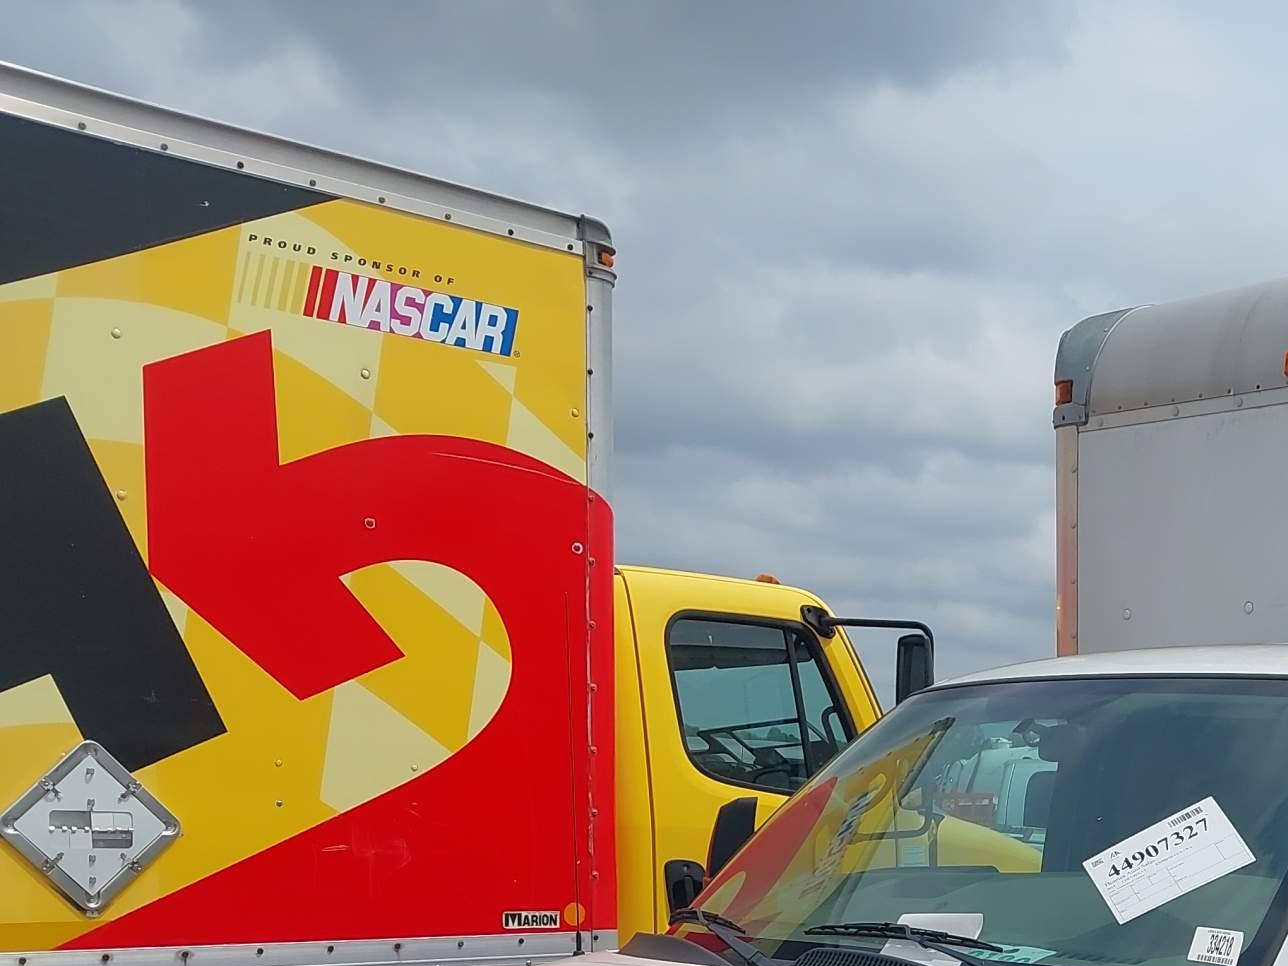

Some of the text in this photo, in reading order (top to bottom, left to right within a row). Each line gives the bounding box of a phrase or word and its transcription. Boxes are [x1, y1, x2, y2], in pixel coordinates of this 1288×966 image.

[248, 234, 456, 286] PROUD SPONSOR OF
[327, 270, 509, 355] NASCAR
[1108, 817, 1208, 877] 44907327
[504, 912, 558, 928] MARION
[1206, 934, 1235, 957] 334218
